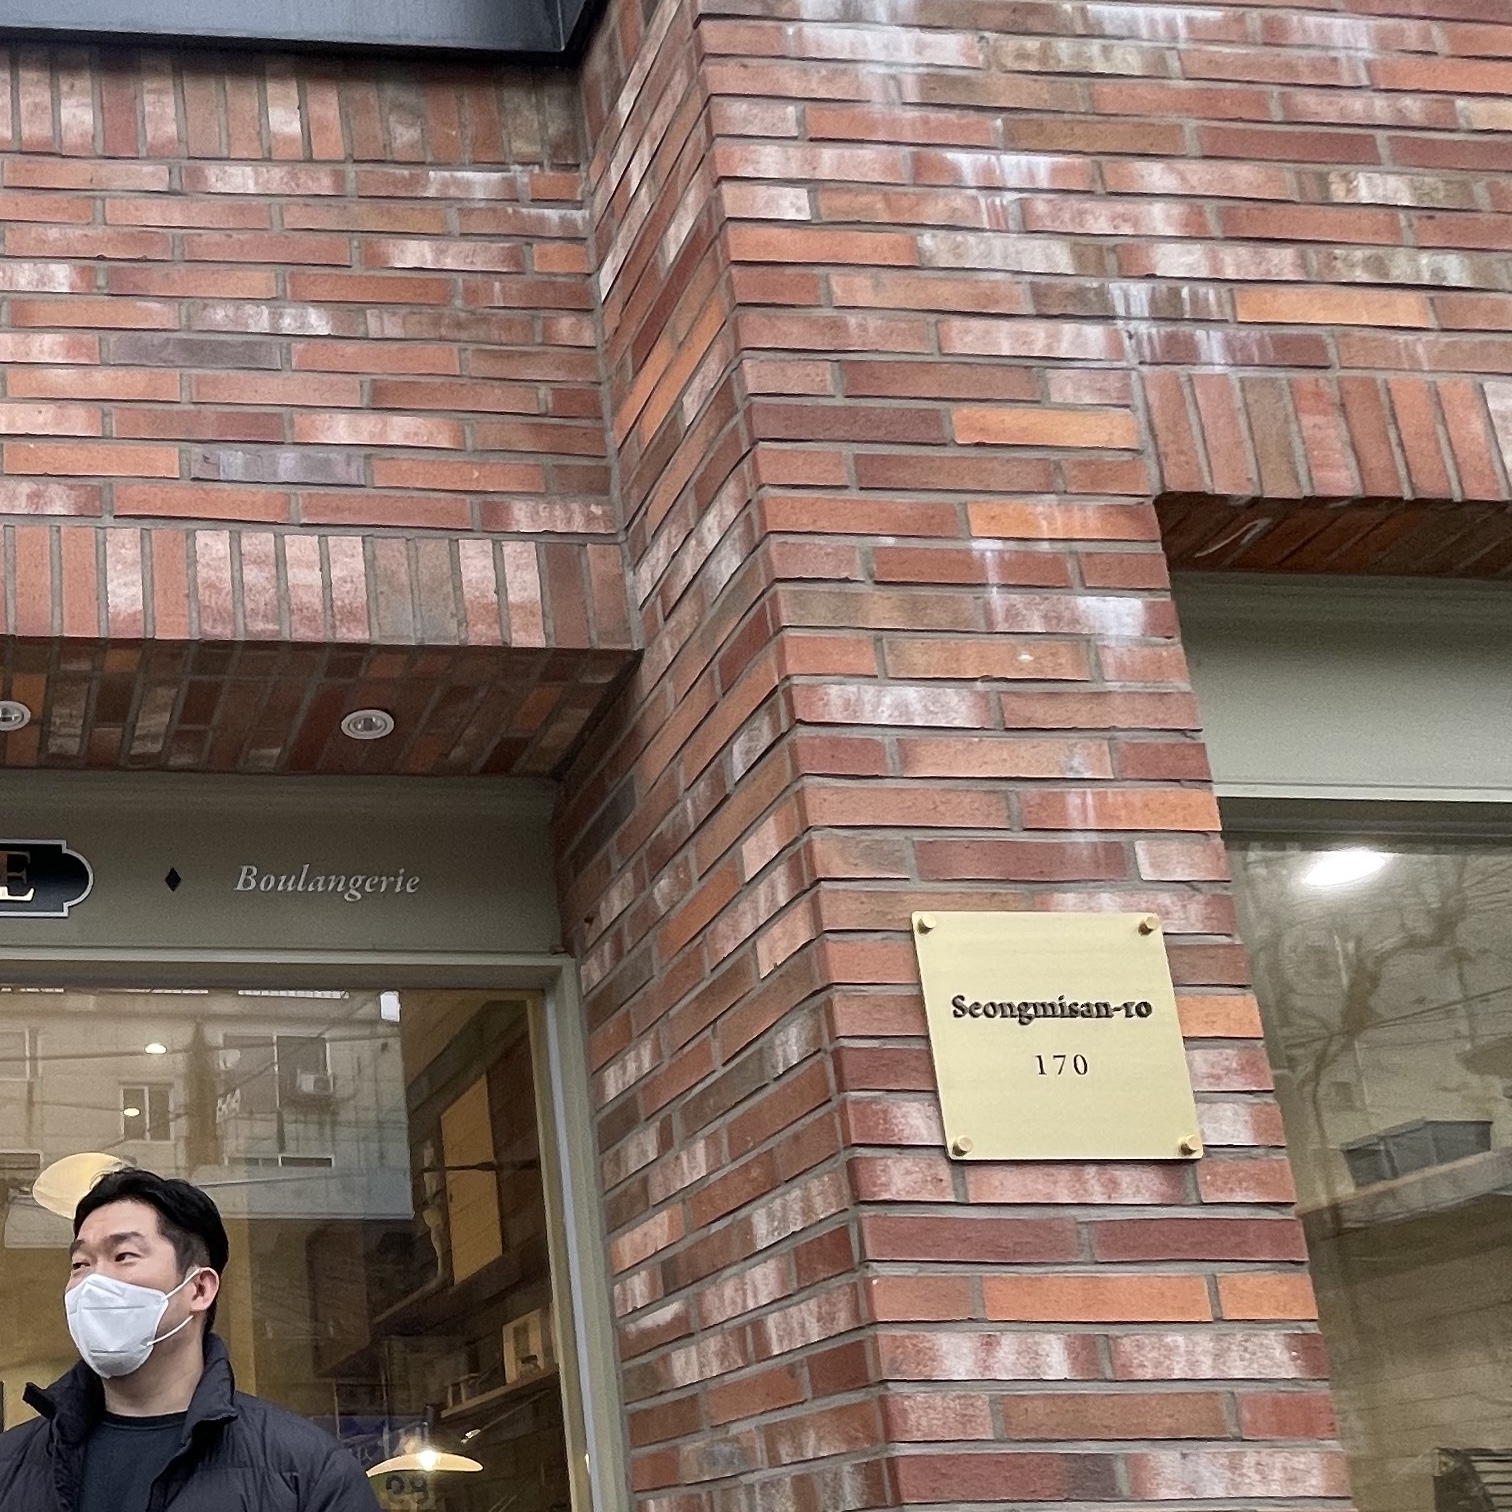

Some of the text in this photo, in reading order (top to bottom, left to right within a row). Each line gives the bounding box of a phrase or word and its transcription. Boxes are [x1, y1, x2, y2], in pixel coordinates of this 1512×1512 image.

[234, 864, 420, 903] Boulangerie
[951, 994, 1153, 1026] Seongmisan-ro
[1035, 1054, 1088, 1076] 170
